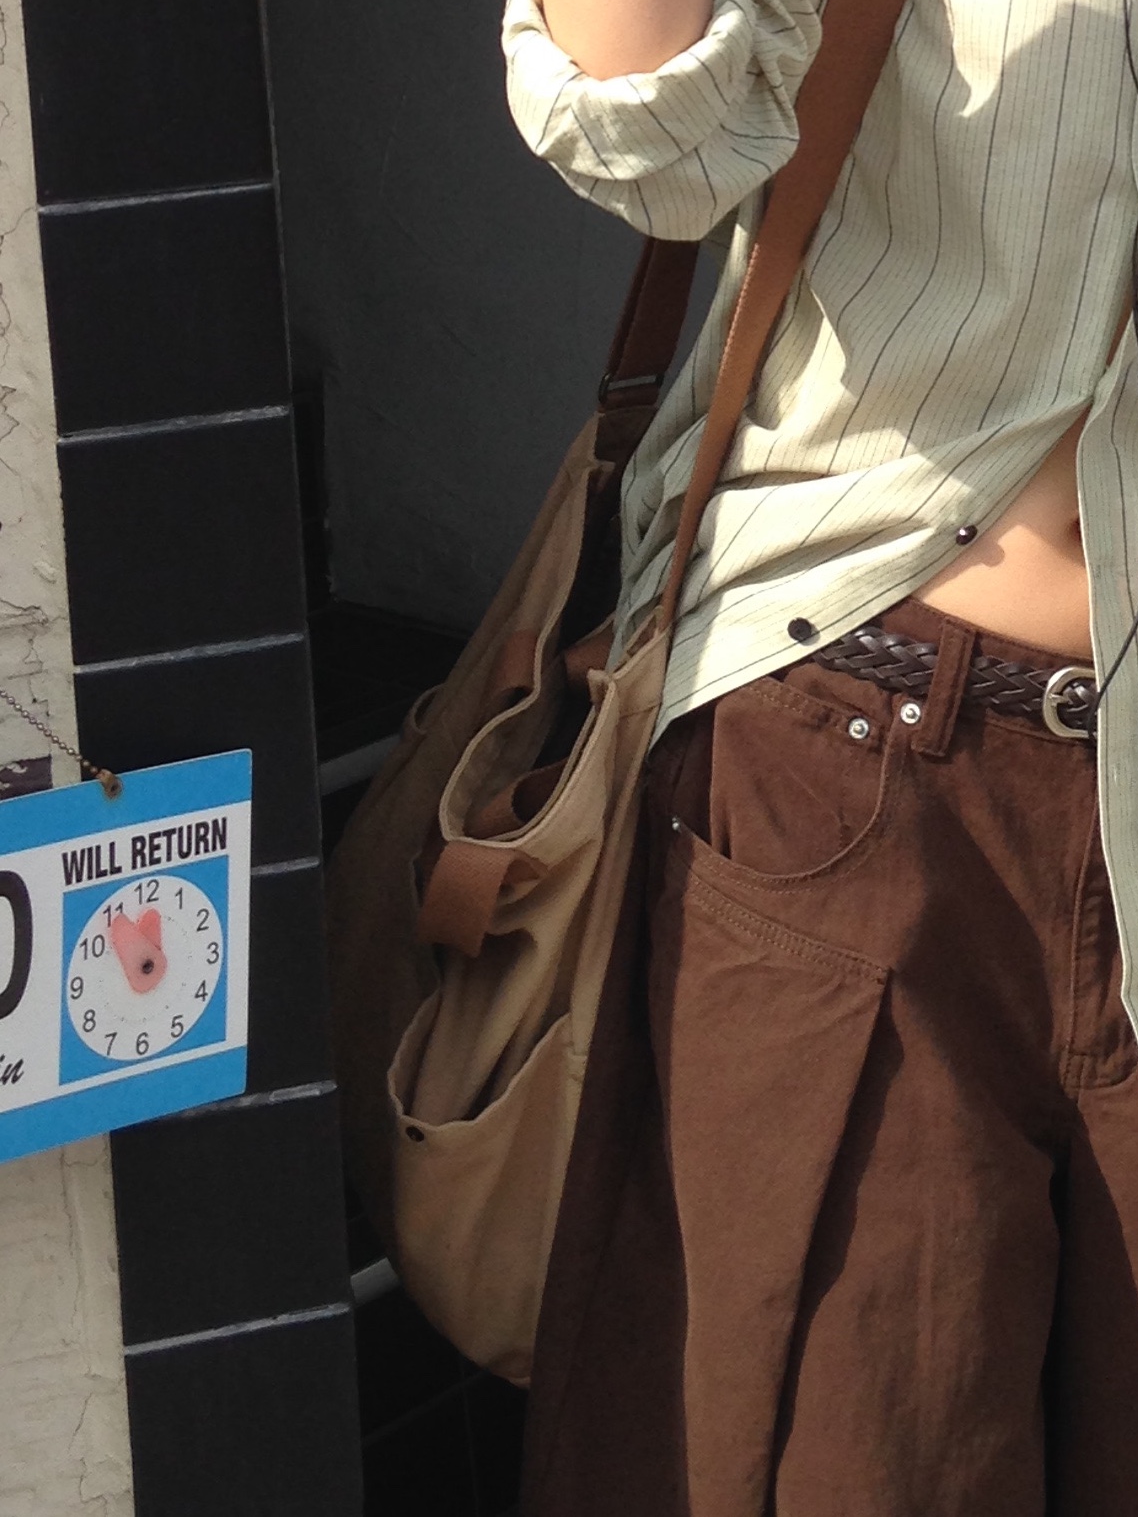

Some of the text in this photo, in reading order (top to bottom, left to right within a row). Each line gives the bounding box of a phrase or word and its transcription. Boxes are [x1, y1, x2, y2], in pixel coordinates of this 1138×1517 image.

[62, 817, 227, 886] WILL RETURN
[133, 879, 160, 905] 12
[175, 887, 183, 910] 1
[196, 908, 210, 932] 2
[79, 934, 105, 961] 10
[206, 941, 220, 964] 3
[70, 976, 84, 1000] 9
[194, 979, 209, 1002] 4
[82, 1009, 96, 1033] 8
[170, 1014, 184, 1038] 5
[104, 1032, 118, 1056] 7
[135, 1032, 149, 1056] 6
